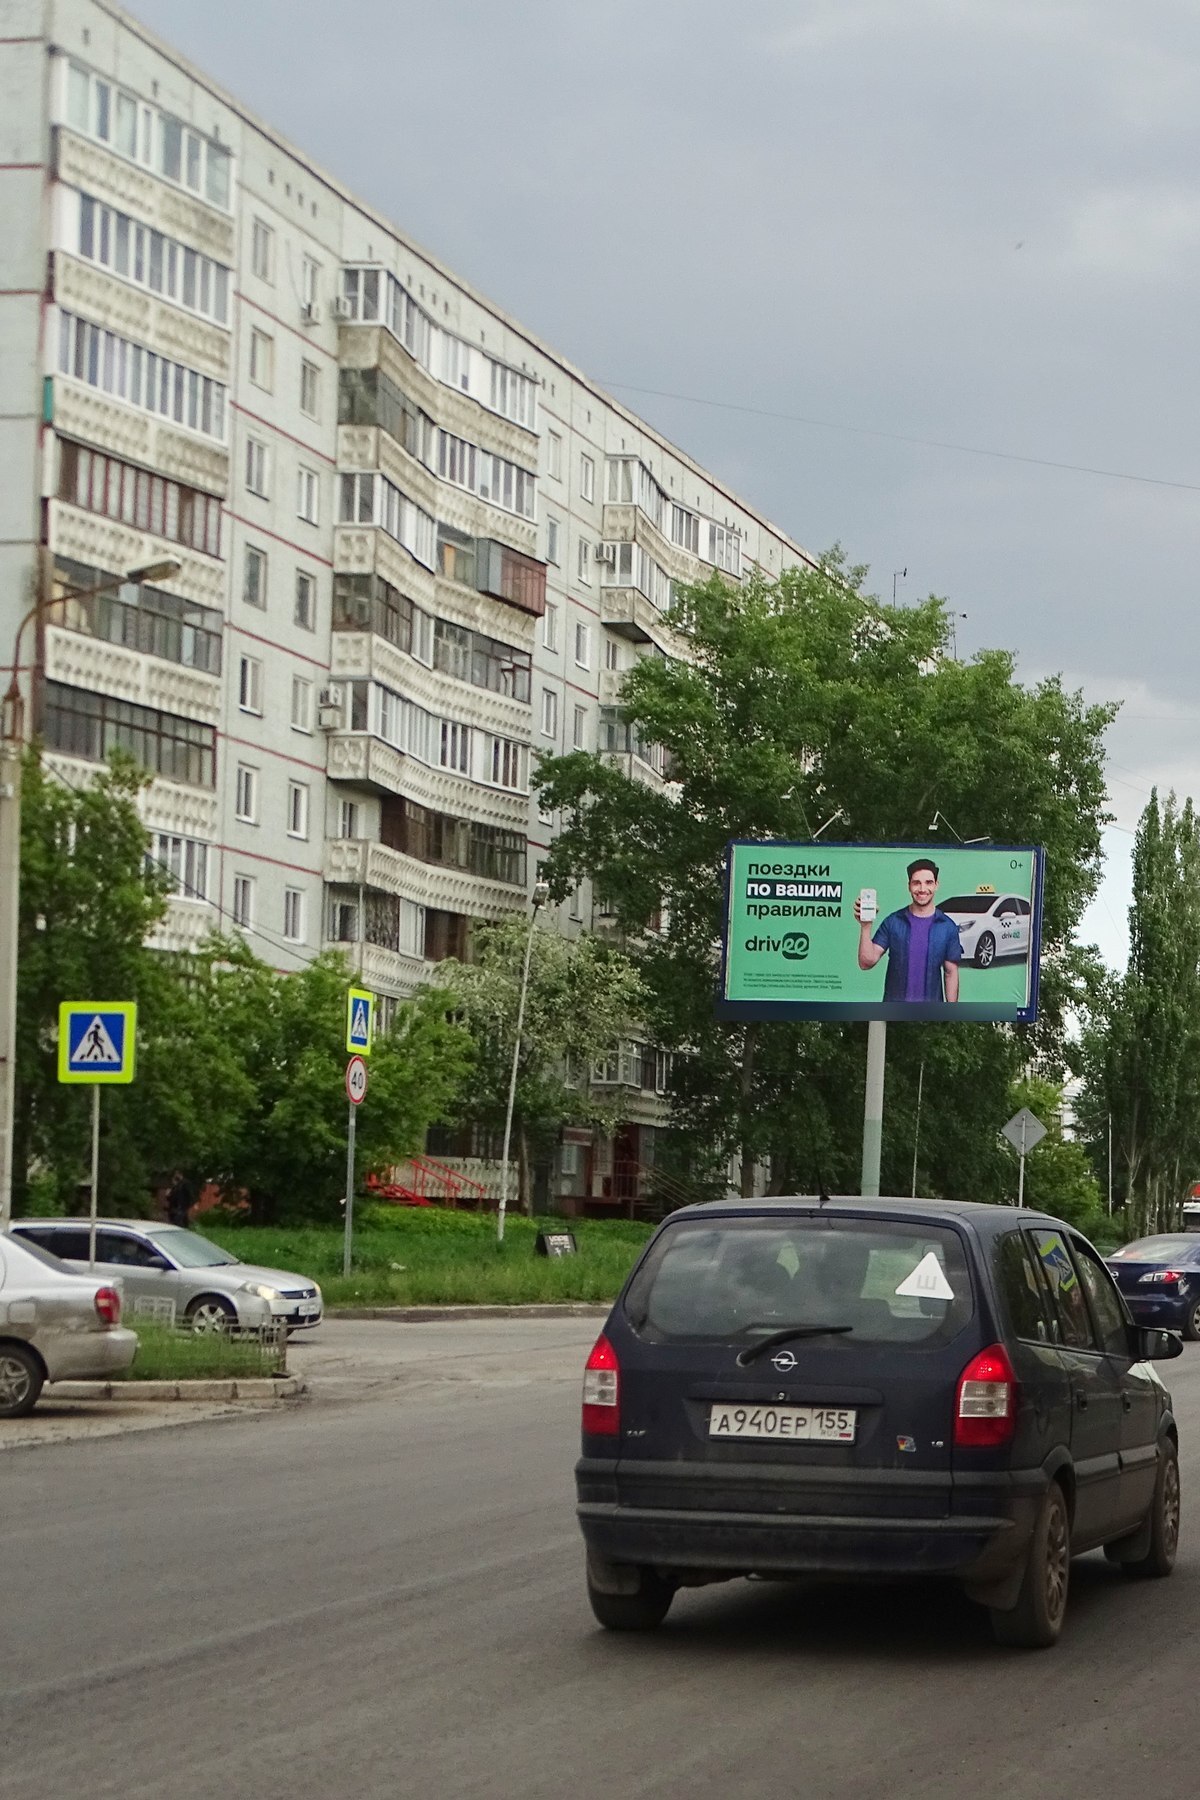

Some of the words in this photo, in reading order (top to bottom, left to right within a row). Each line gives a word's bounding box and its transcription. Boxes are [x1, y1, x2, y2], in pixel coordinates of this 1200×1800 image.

[748, 863, 830, 878] поездки
[1010, 859, 1023, 870] 0+
[747, 883, 771, 896] по
[775, 884, 841, 898] вашим
[746, 904, 841, 920] правилам
[745, 932, 809, 960] drivee
[351, 1072, 364, 1089] 40
[917, 1274, 937, 1290] Ш
[814, 1410, 849, 1430] 155
[821, 1430, 839, 1438] RUS
